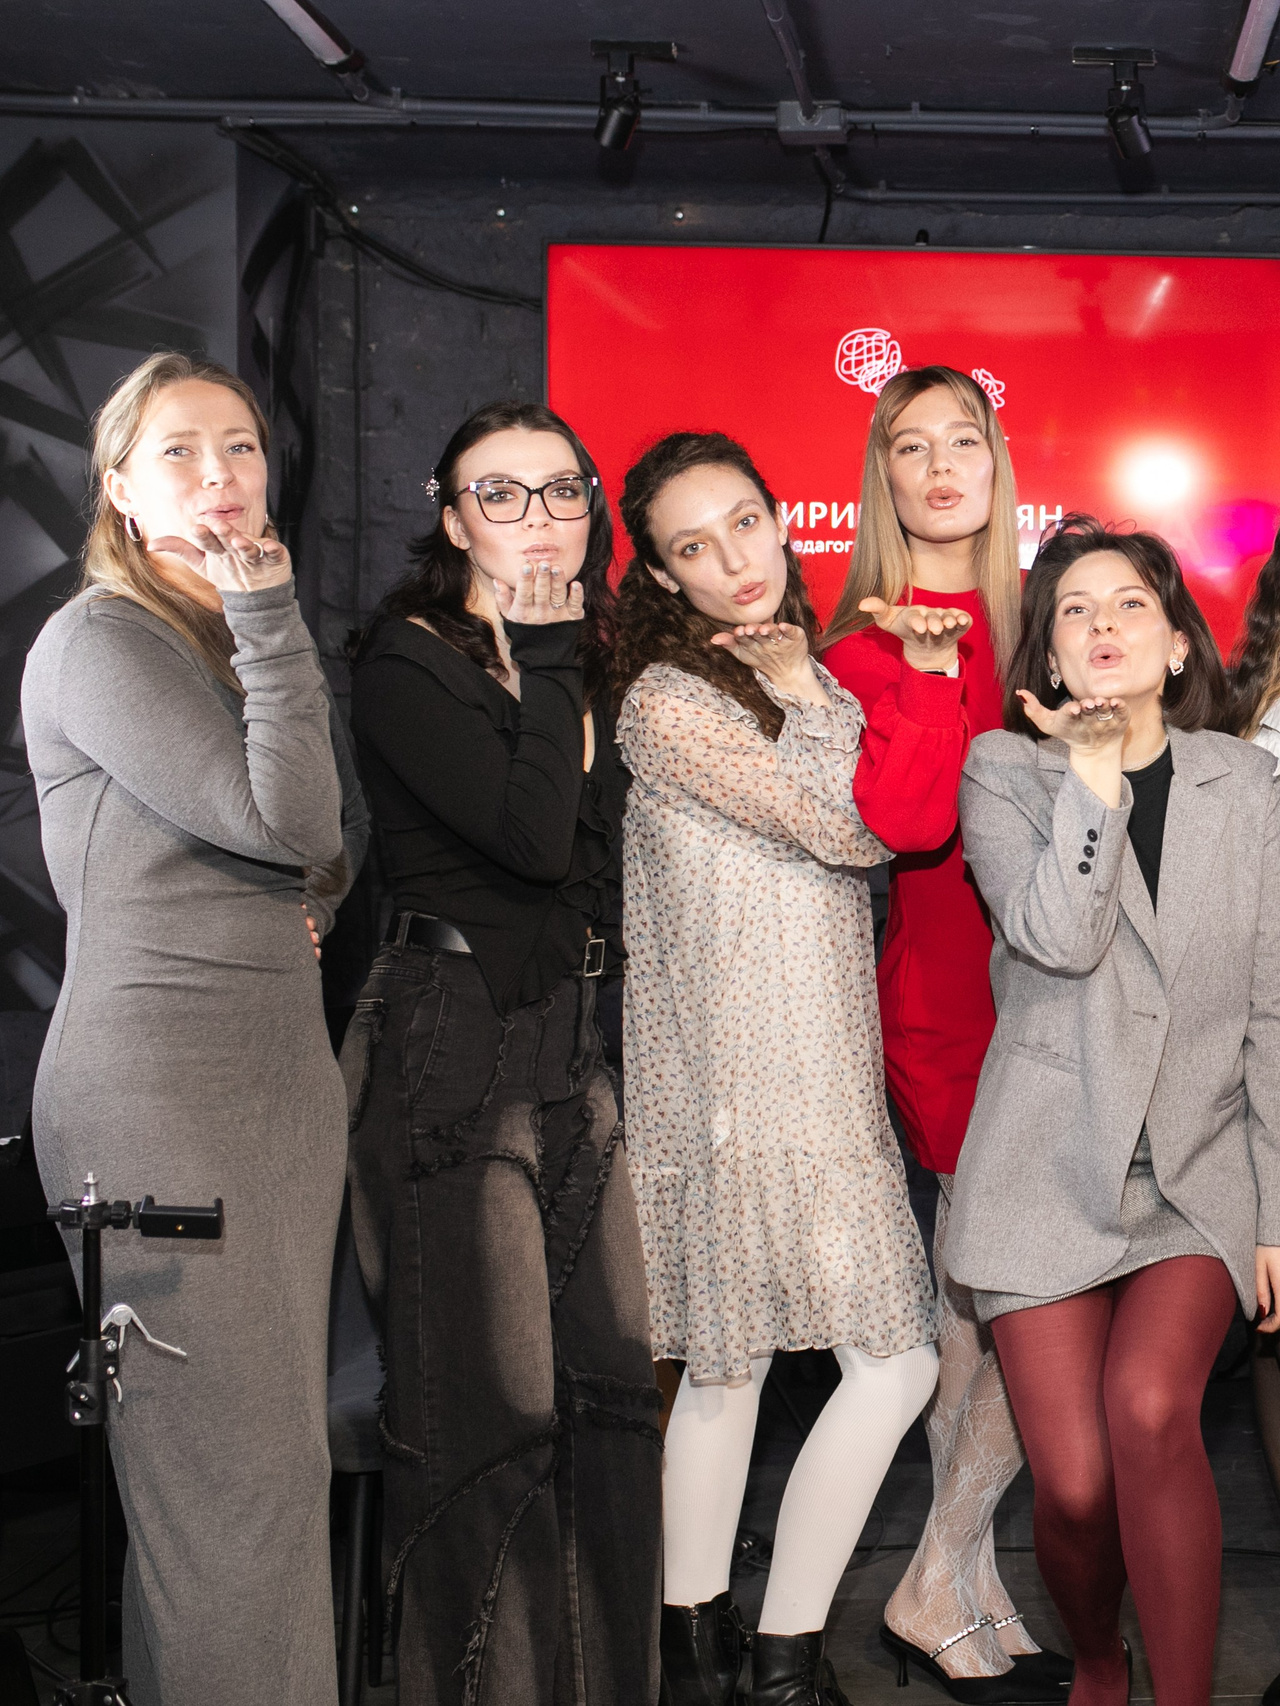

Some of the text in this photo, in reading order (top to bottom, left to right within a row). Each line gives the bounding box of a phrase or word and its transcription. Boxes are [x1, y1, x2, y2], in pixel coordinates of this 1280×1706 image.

[781, 501, 1063, 531] ИРИ ЯН
[792, 539, 854, 555] едагог
